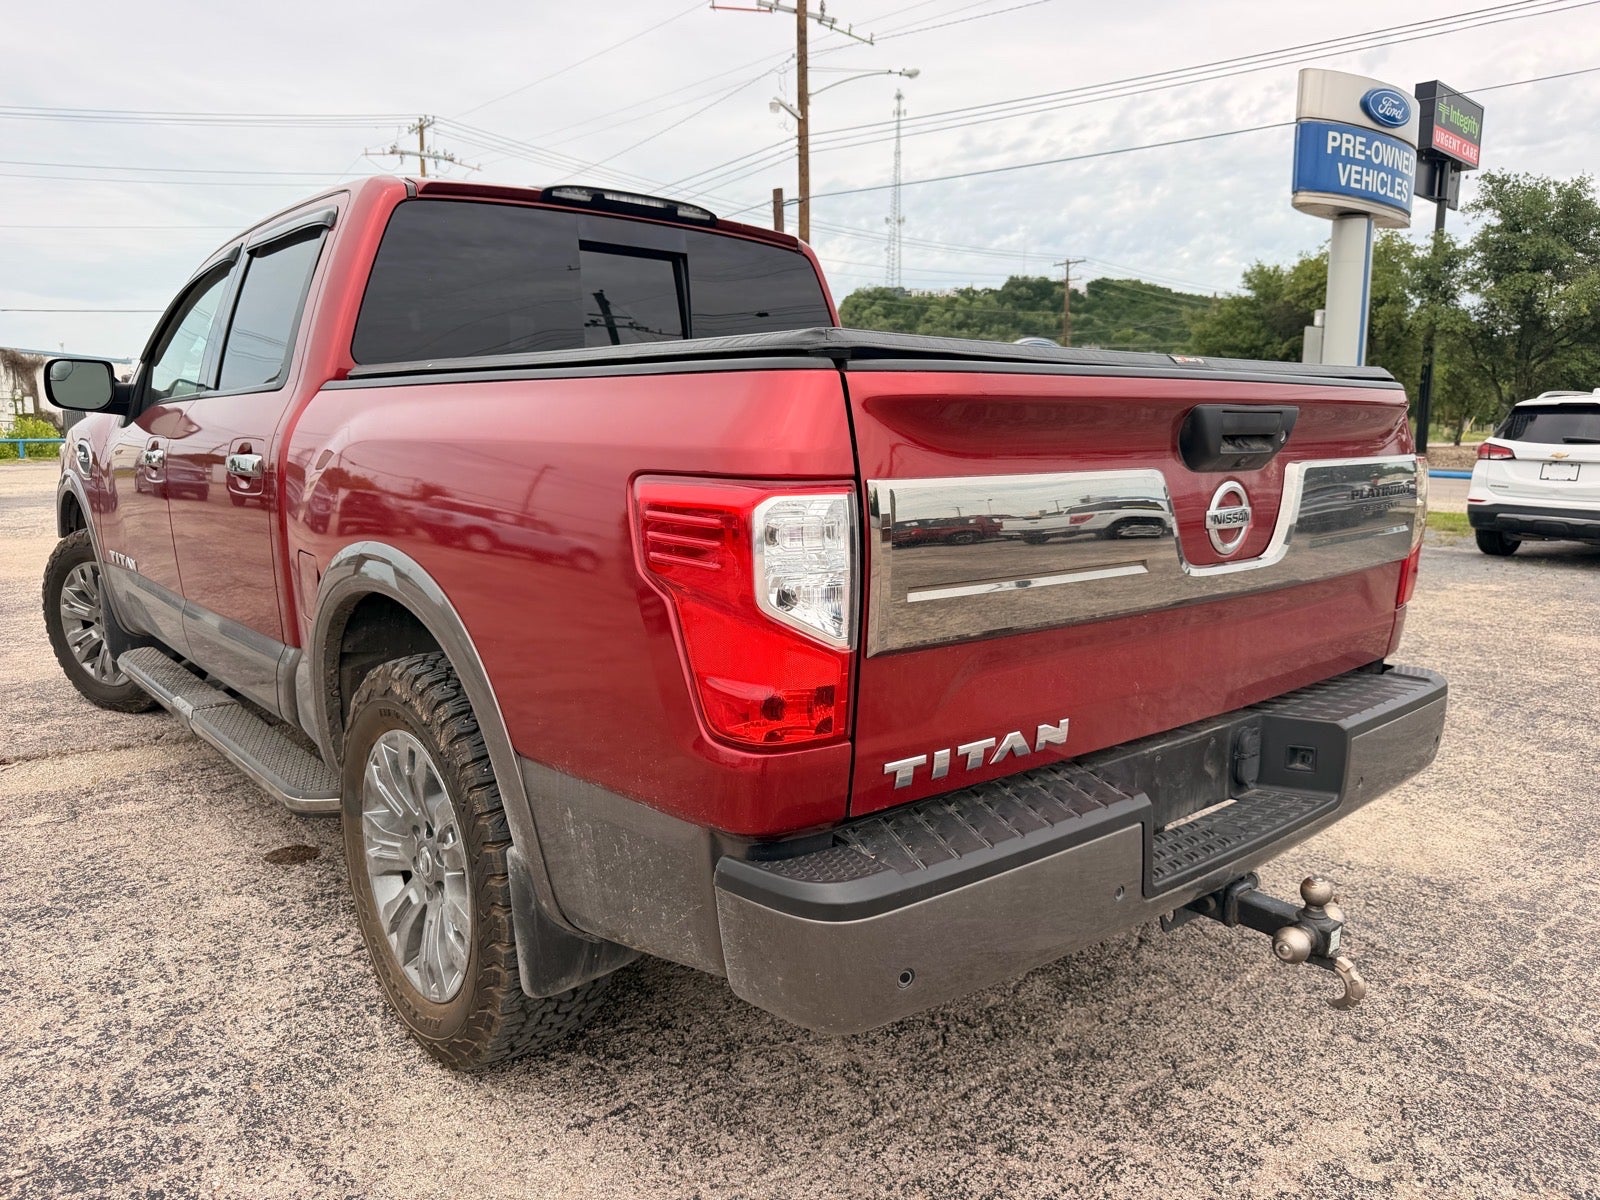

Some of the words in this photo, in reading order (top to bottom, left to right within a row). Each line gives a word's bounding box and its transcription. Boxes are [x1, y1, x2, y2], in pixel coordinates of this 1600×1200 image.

[1378, 96, 1405, 119] Ford
[1450, 104, 1480, 139] Integrity
[1327, 131, 1415, 176] PRE-OWNED
[1435, 130, 1460, 152] URGENT
[1462, 143, 1478, 160] CARE
[1338, 162, 1409, 202] VEHICLES
[1351, 484, 1410, 500] PLATINUM
[1212, 509, 1250, 525] NISSAN
[109, 549, 138, 572] TITAN
[883, 718, 1070, 789] TITAN
